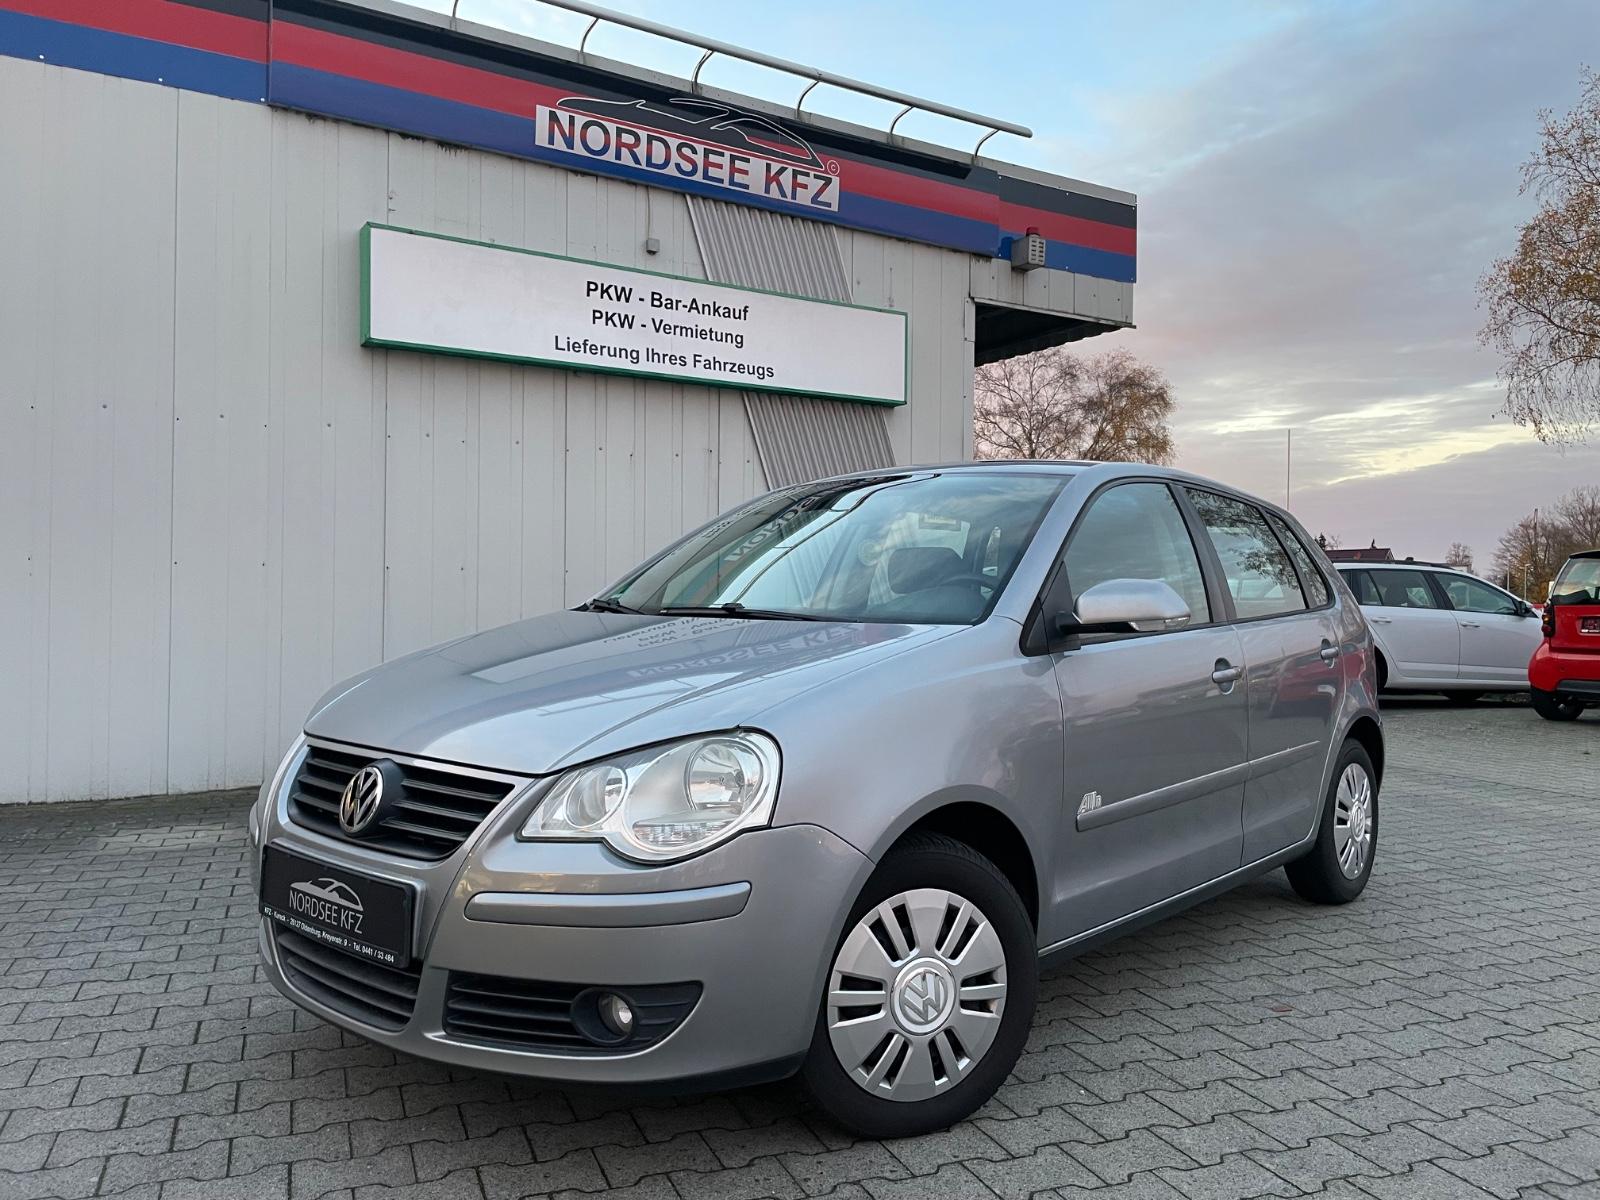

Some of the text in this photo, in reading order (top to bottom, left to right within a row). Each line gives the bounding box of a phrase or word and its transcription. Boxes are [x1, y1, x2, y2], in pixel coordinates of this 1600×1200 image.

[548, 110, 750, 190] NORDSEE
[764, 162, 833, 208] KFZ
[586, 280, 633, 304] PKW
[650, 291, 750, 321] Bar-Ankauf
[592, 310, 635, 330] PKW
[652, 318, 744, 349] Vermietung
[554, 335, 774, 380] Lieferung Ihres Fahrzeugs
[288, 890, 364, 934] NORDSEE KFZ
